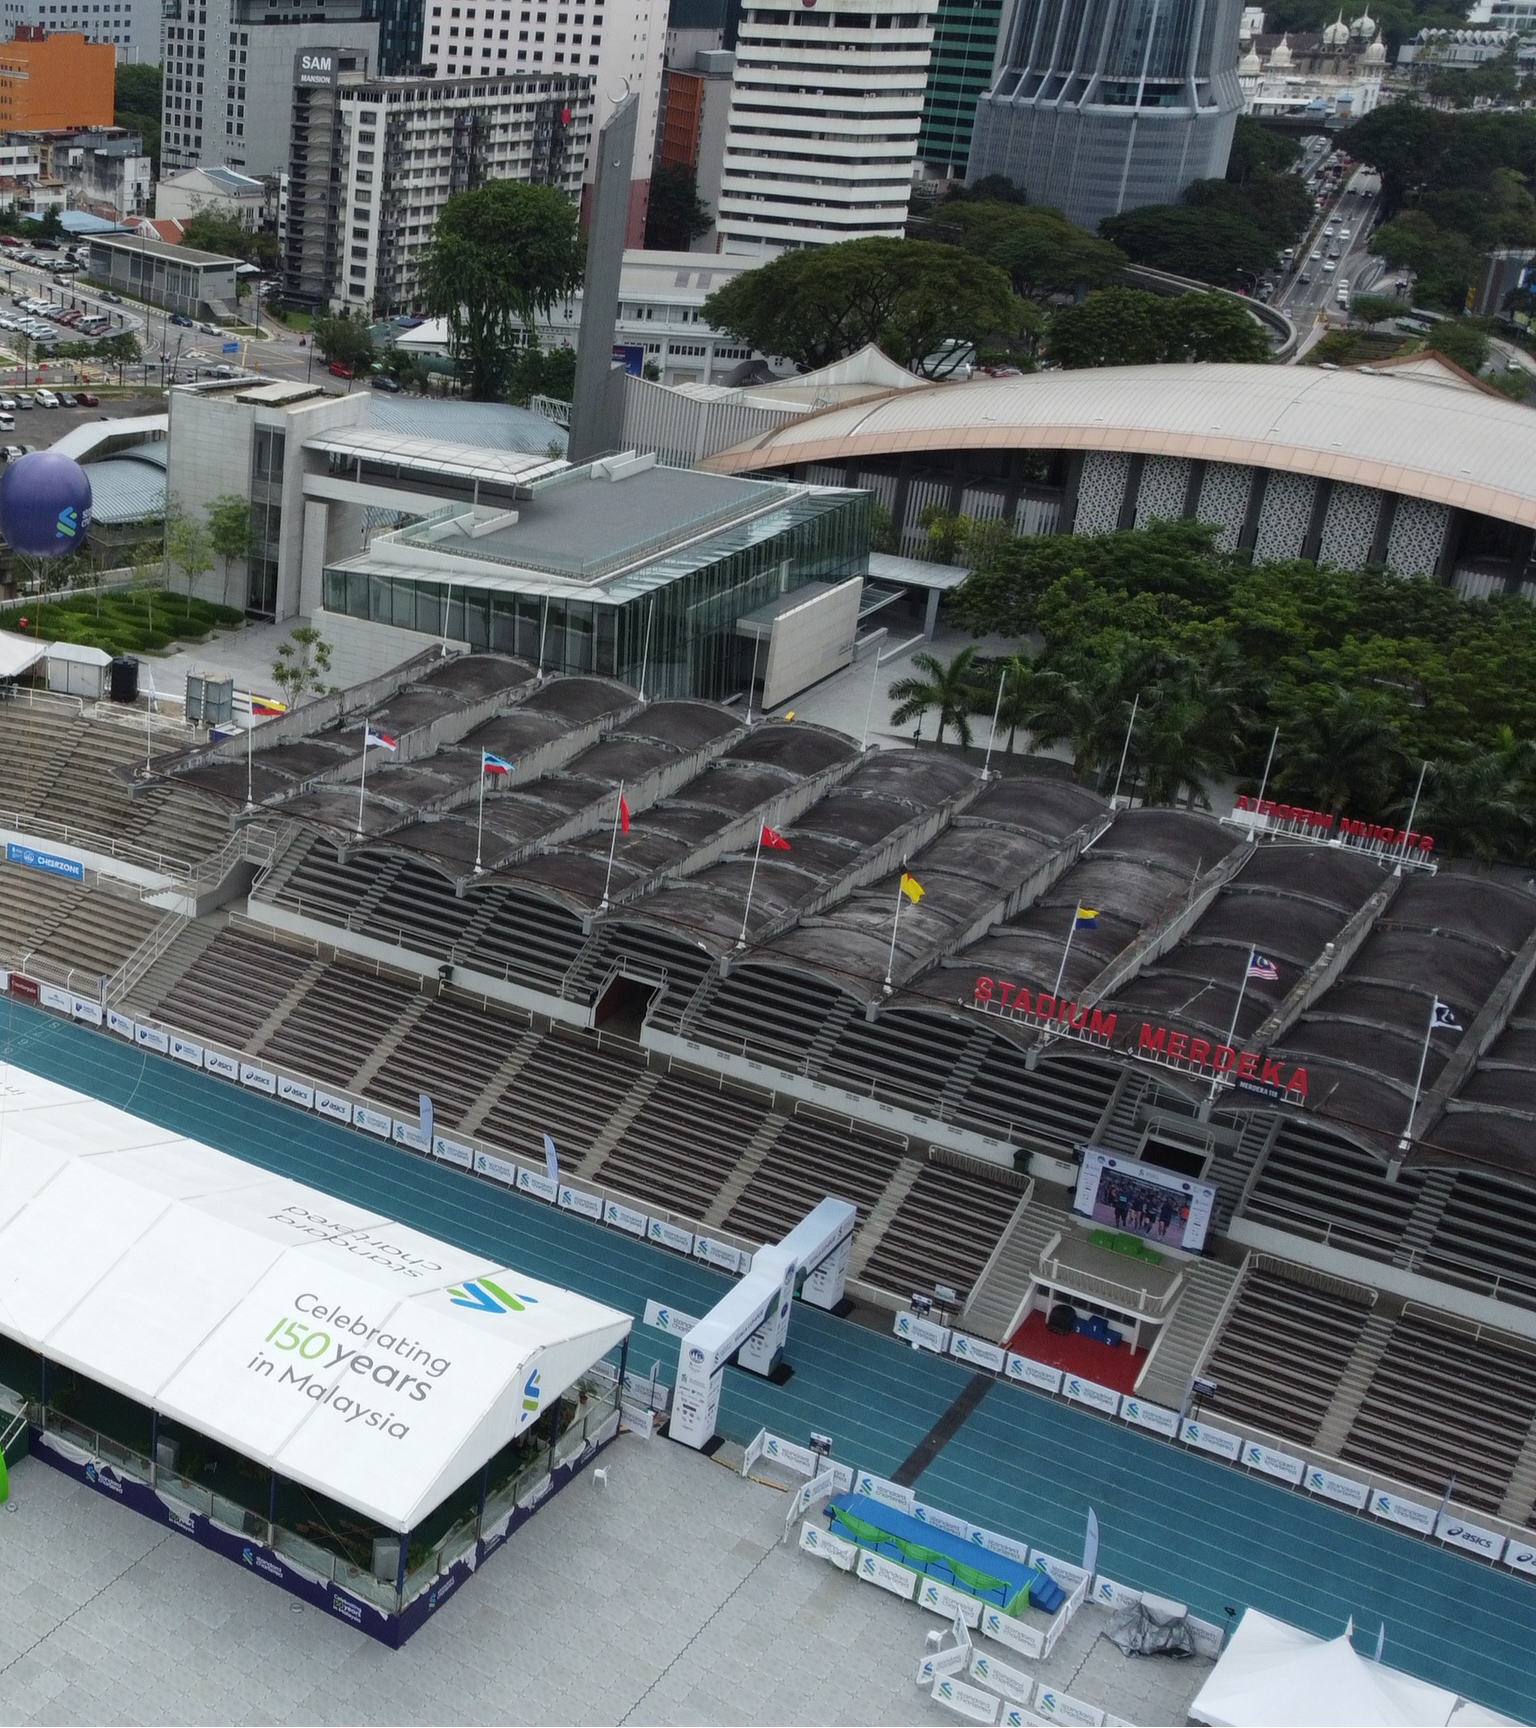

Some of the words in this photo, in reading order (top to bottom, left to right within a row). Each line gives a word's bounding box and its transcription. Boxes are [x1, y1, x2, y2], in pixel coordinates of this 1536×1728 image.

[300, 74, 331, 84] MANSION
[301, 56, 332, 71] SAM
[37, 857, 80, 876] CHEERZONE
[975, 976, 1117, 1038] STADIUM
[1138, 1024, 1309, 1097] MERDEKA
[1238, 1080, 1268, 1095] MERDEKA
[270, 1214, 424, 1278] standard
[282, 1205, 443, 1271] chartered
[264, 1317, 329, 1359] 150
[327, 1339, 432, 1404] years
[294, 1290, 452, 1378] Celebrating
[247, 1349, 271, 1373] in
[277, 1361, 411, 1441] Malaysia
[1462, 1531, 1492, 1549] asics
